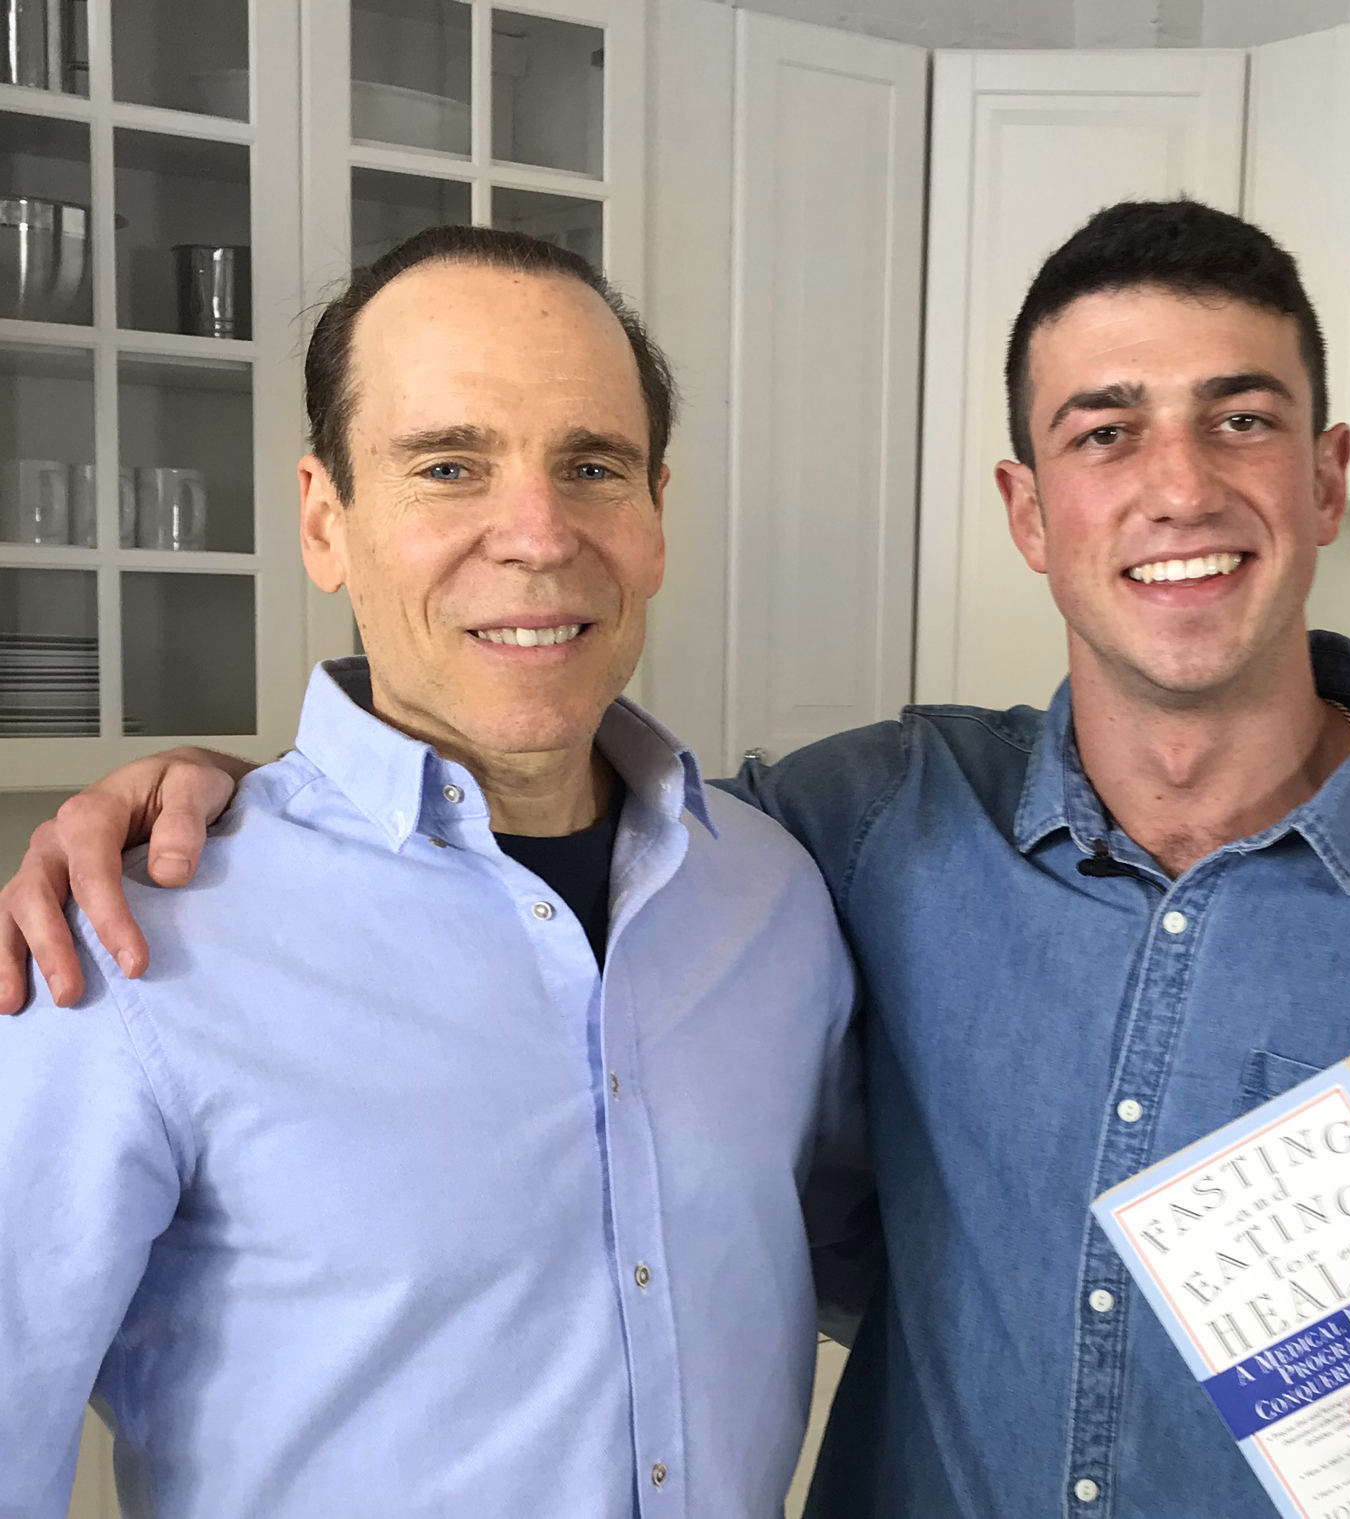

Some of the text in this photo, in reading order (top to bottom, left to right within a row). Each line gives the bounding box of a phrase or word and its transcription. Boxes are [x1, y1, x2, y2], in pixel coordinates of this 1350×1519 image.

[1266, 1249, 1321, 1280] for
[1235, 1365, 1257, 1387] A
[1253, 1320, 1348, 1375] MEDICAL
